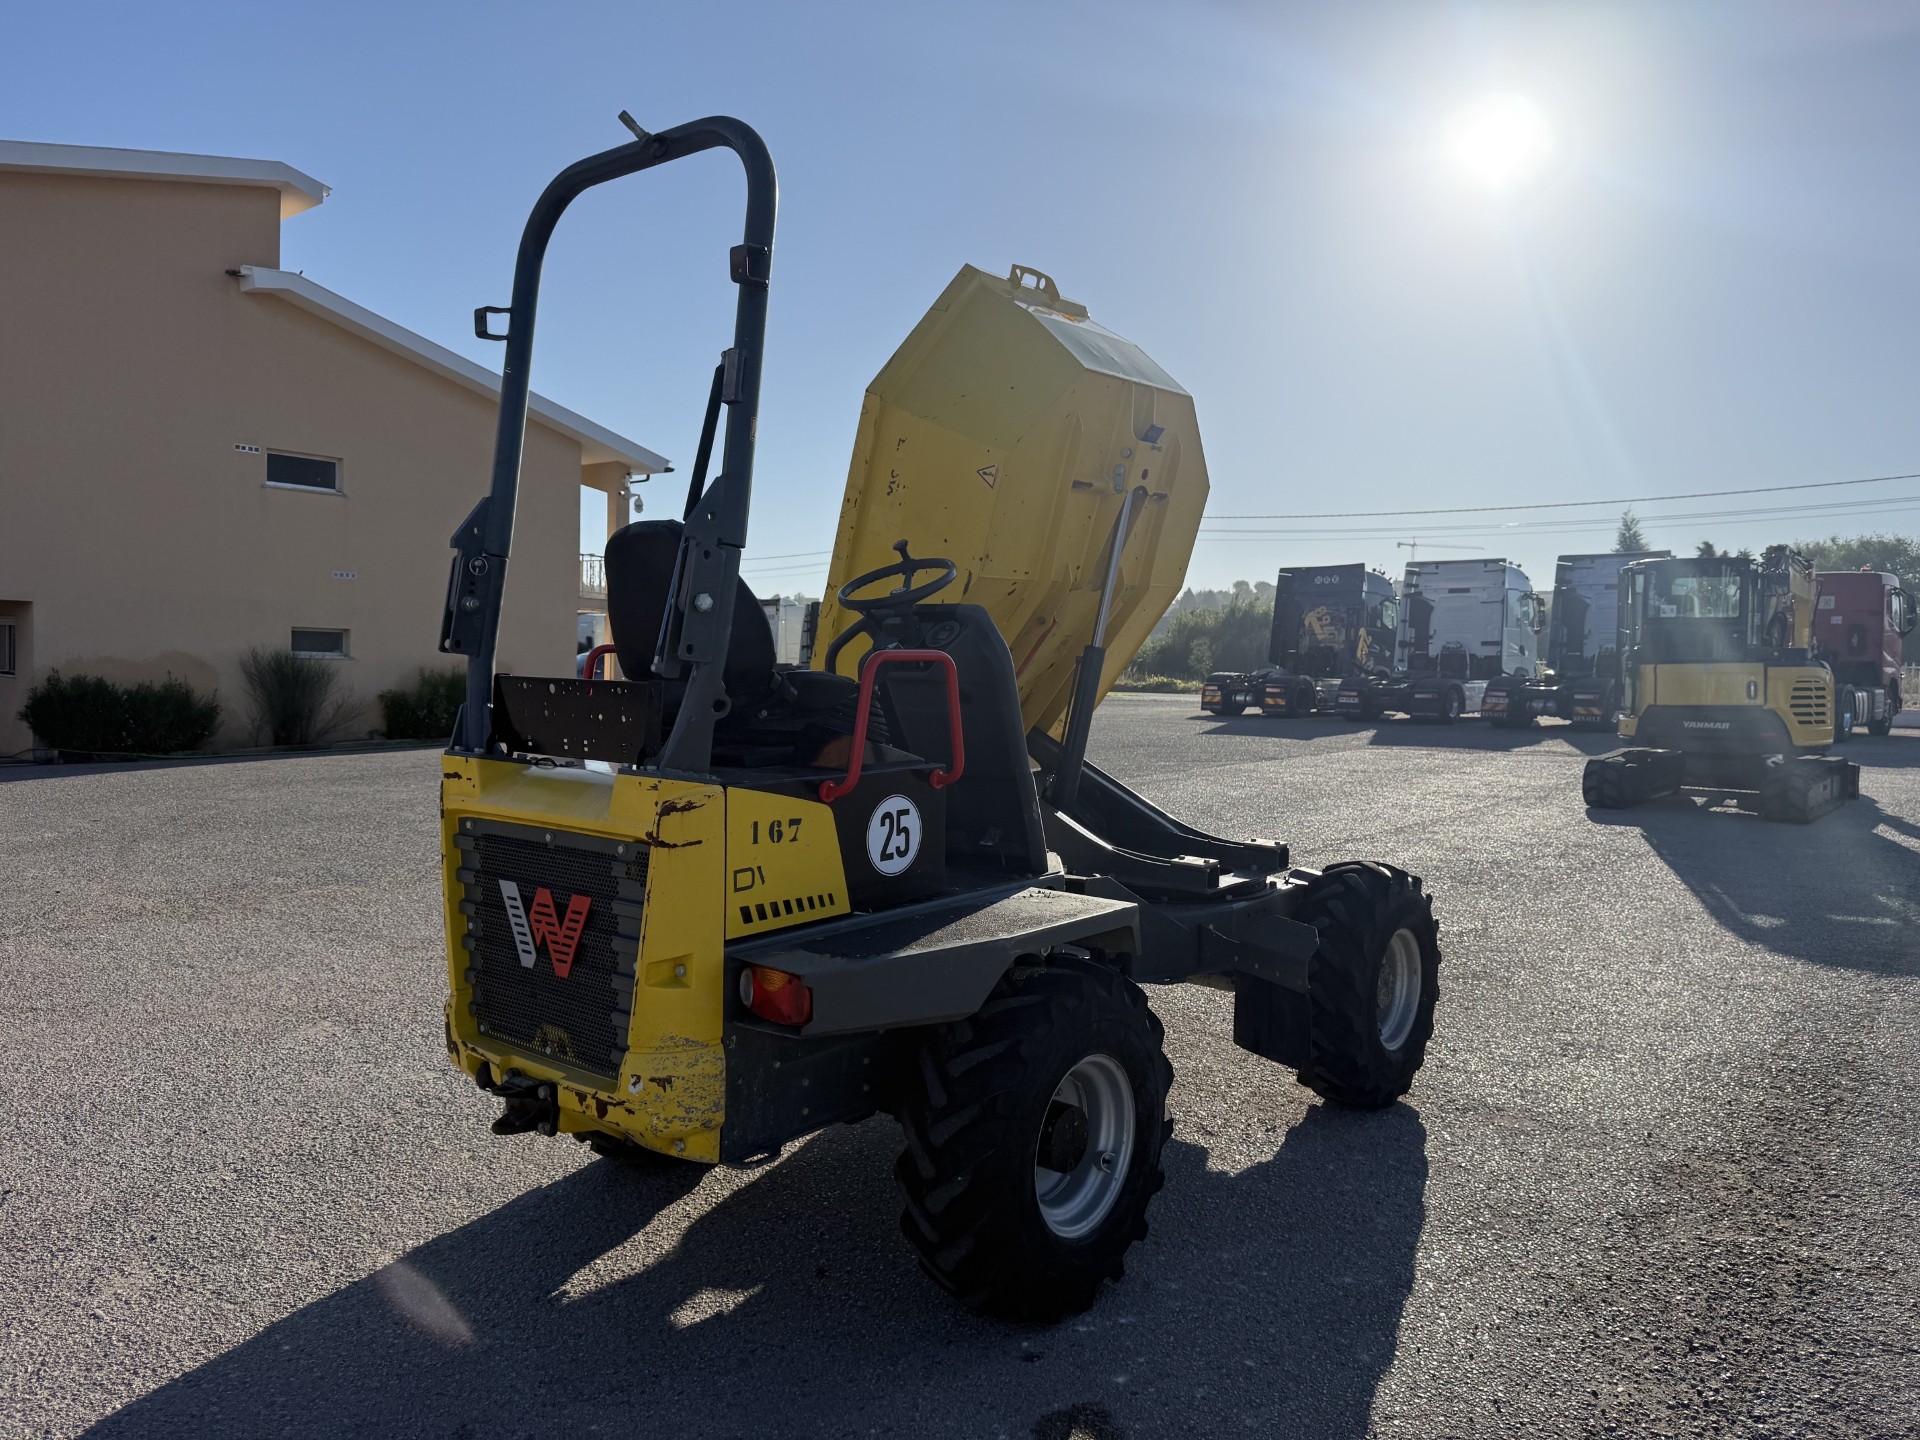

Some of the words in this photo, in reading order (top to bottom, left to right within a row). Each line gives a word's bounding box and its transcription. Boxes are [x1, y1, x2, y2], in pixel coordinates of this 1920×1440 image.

[1683, 720, 1730, 729] YANMAR
[751, 818, 802, 844] 167
[880, 808, 910, 862] 25
